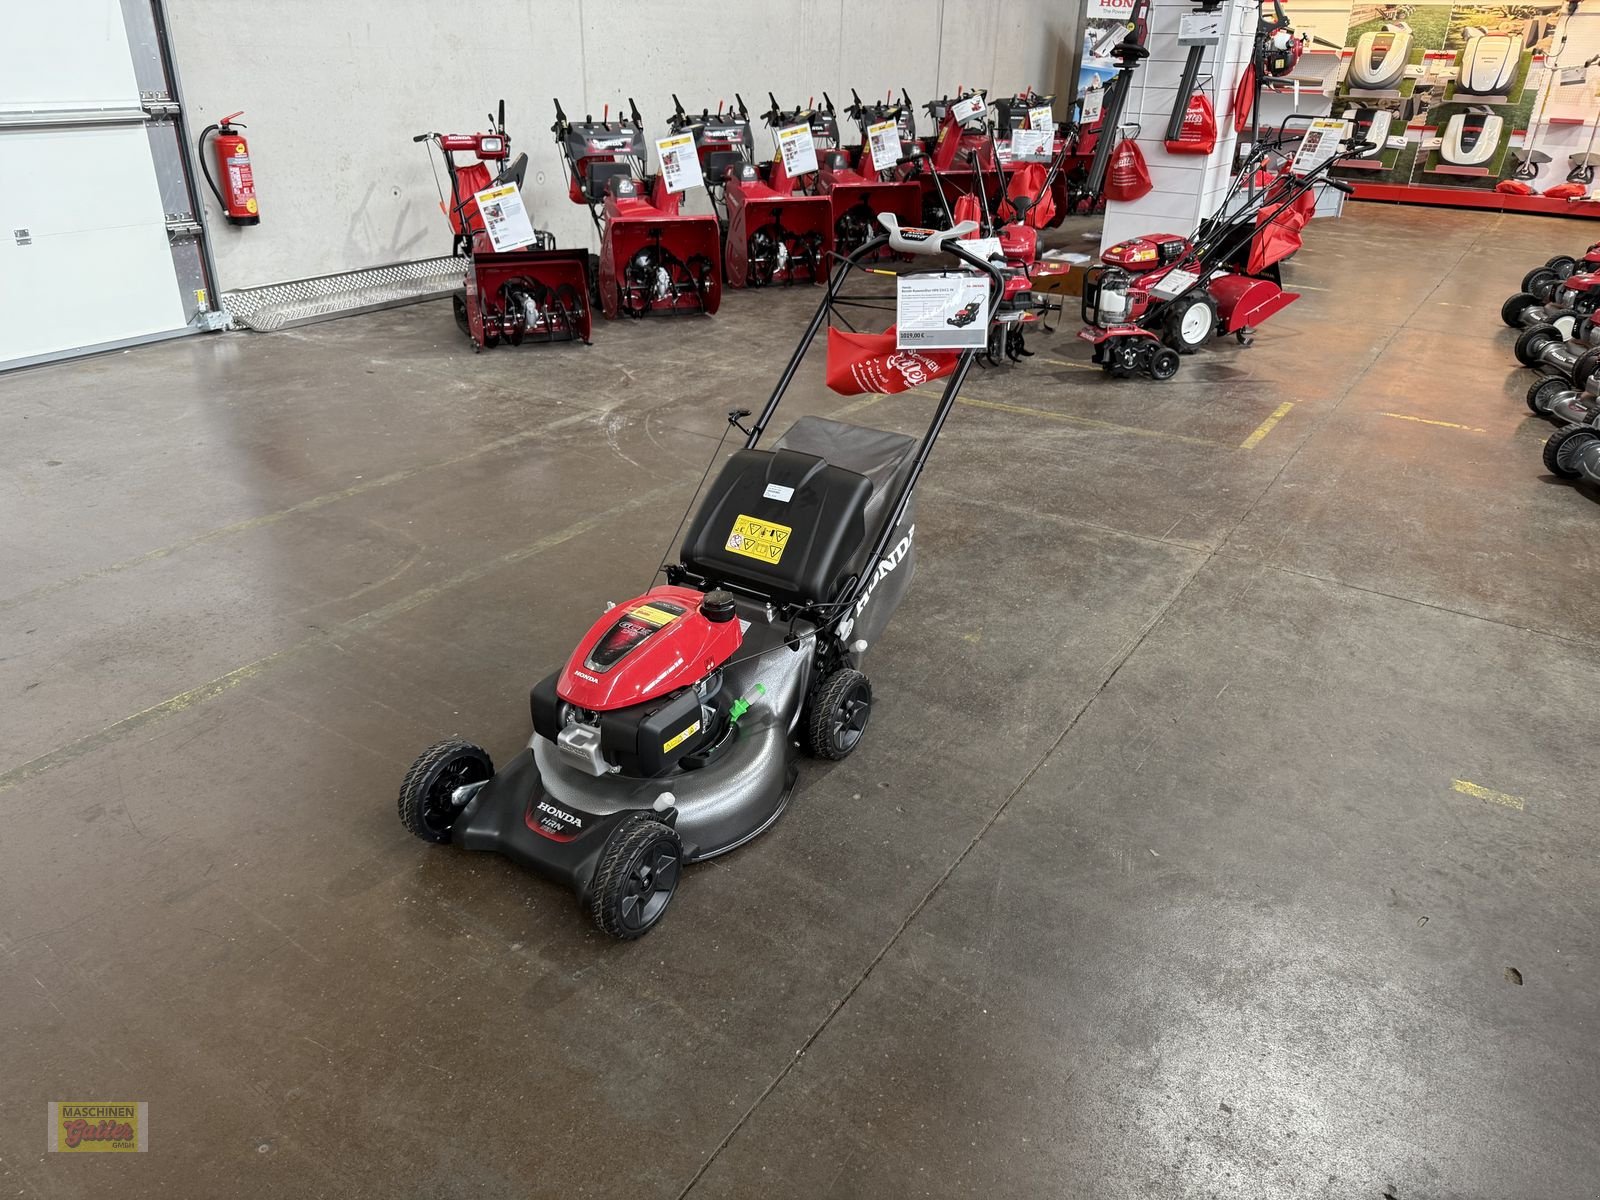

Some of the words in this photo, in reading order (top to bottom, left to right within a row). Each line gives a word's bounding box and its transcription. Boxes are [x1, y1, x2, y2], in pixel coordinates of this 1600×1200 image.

[1099, 0, 1133, 8] HON
[574, 669, 599, 684] HONDA
[536, 801, 582, 828] HONDA
[541, 816, 565, 831] HRN
